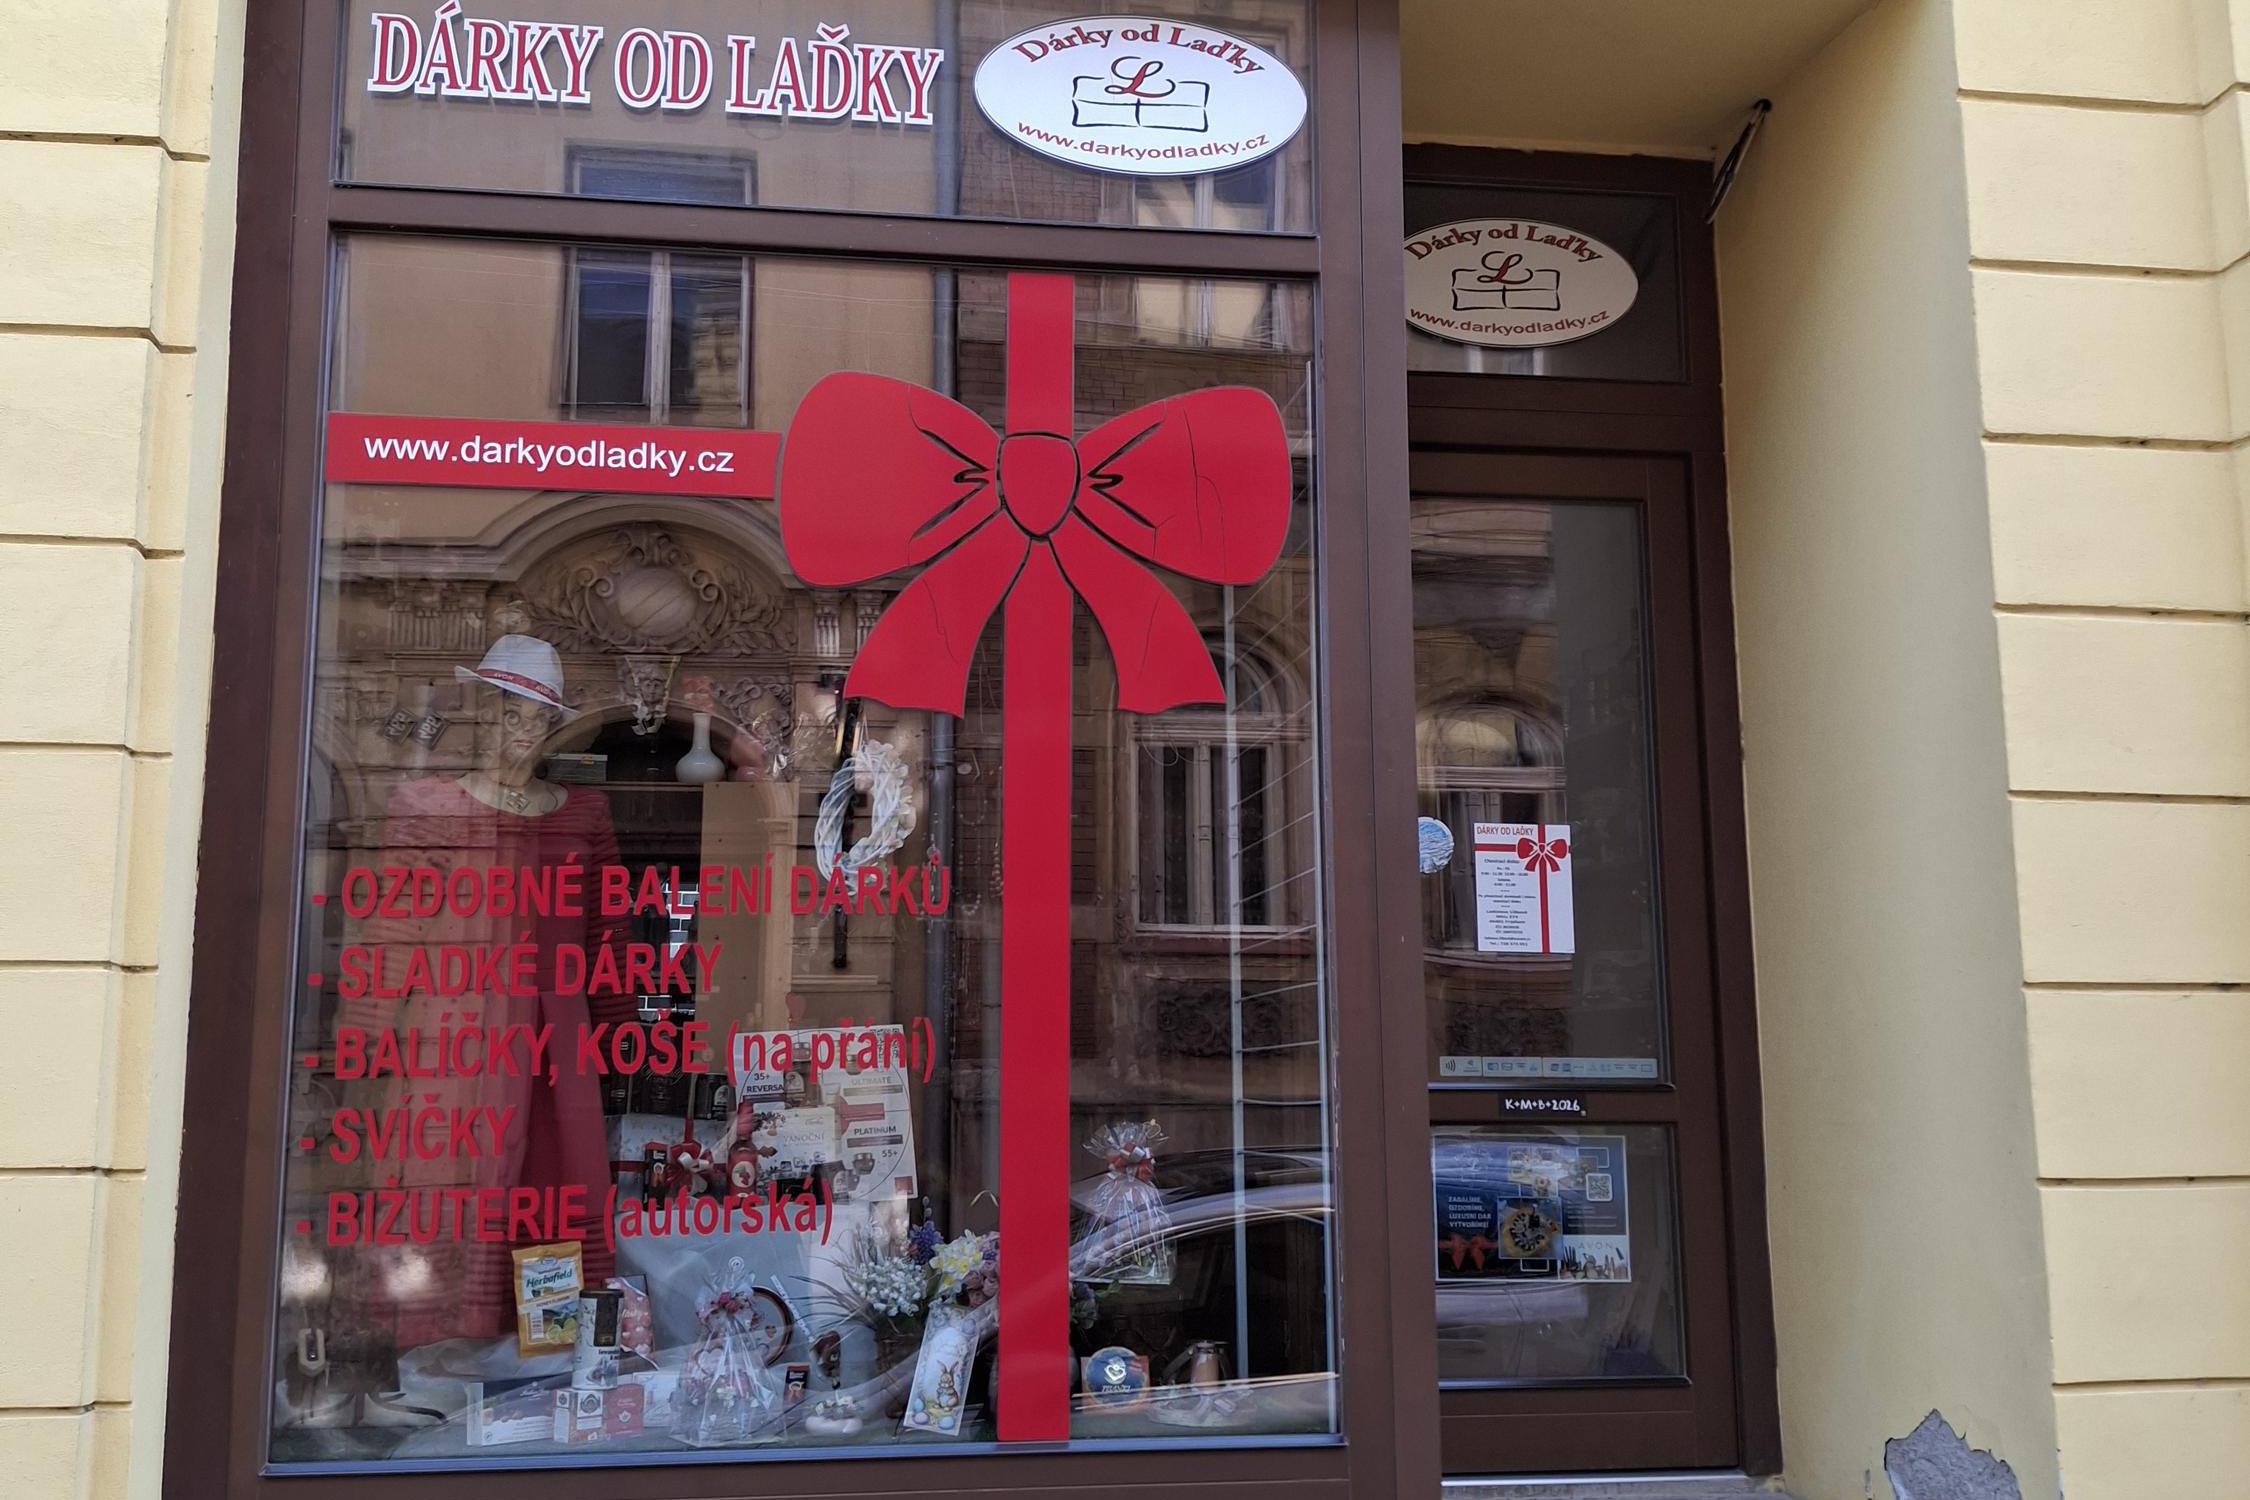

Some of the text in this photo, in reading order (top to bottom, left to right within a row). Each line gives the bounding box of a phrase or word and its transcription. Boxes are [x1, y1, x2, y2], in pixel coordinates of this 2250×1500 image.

[367, 0, 945, 125] DÁRKY OD LAĎKY
[1012, 24, 1265, 74] Dárky od Laďky
[1018, 122, 1269, 160] www.darkyodladky.cz
[1404, 224, 1603, 262] Dárky od Laďky
[1410, 308, 1610, 336] www.darkyodladky.cz
[364, 435, 734, 477] www.darkyodladky.cz
[1476, 824, 1499, 835] DÁRKY
[1500, 826, 1511, 836] OD
[342, 852, 585, 918] OZDOBNÉ
[600, 851, 774, 916] BALENÍ
[789, 852, 951, 917] DÁRKŮ
[338, 931, 540, 999] SLADKÉ
[554, 930, 723, 996] DÁRKY
[334, 1010, 559, 1087] BALÍČKY,
[576, 1008, 711, 1075] KOŠE
[727, 1020, 794, 1087] (na
[811, 1017, 936, 1085] přání)
[747, 1084, 785, 1093] REVERSA
[754, 1073, 770, 1081] 35+
[331, 1094, 516, 1163] SVÍČKY
[854, 1126, 897, 1135] PLATINUM
[882, 1150, 898, 1158] 55+
[328, 1177, 588, 1246] BIŽUTERIE
[603, 1180, 833, 1251] (autorská)
